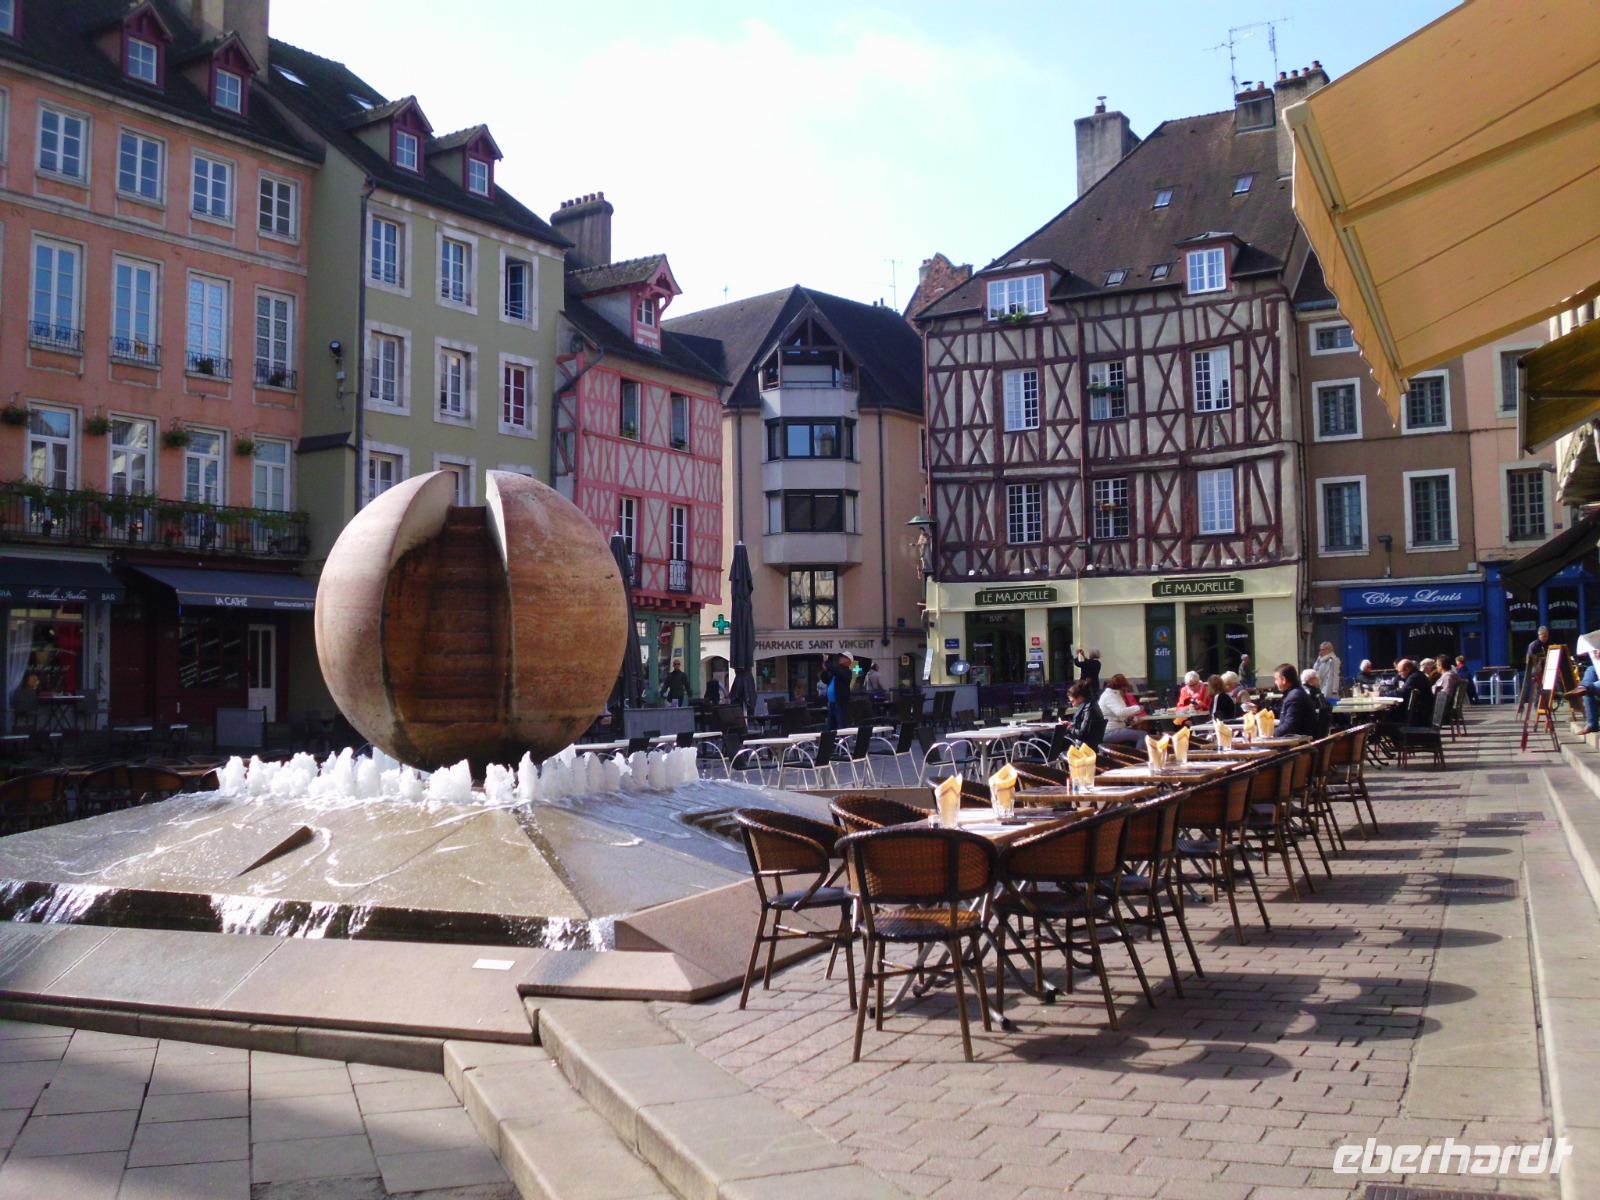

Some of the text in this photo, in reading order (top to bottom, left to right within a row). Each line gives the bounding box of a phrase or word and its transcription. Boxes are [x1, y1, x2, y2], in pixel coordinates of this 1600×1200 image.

[1160, 581, 1236, 595] LE MAJORELLE
[101, 593, 116, 601] BAR
[982, 590, 1049, 603] LE MAJORELLE
[1361, 589, 1463, 607] Chez Louis
[1408, 626, 1427, 638] BAR
[1436, 625, 1454, 636] VIN
[752, 640, 875, 650] PHARMACIE SAINT VINCENT
[1154, 647, 1171, 657] Leffe
